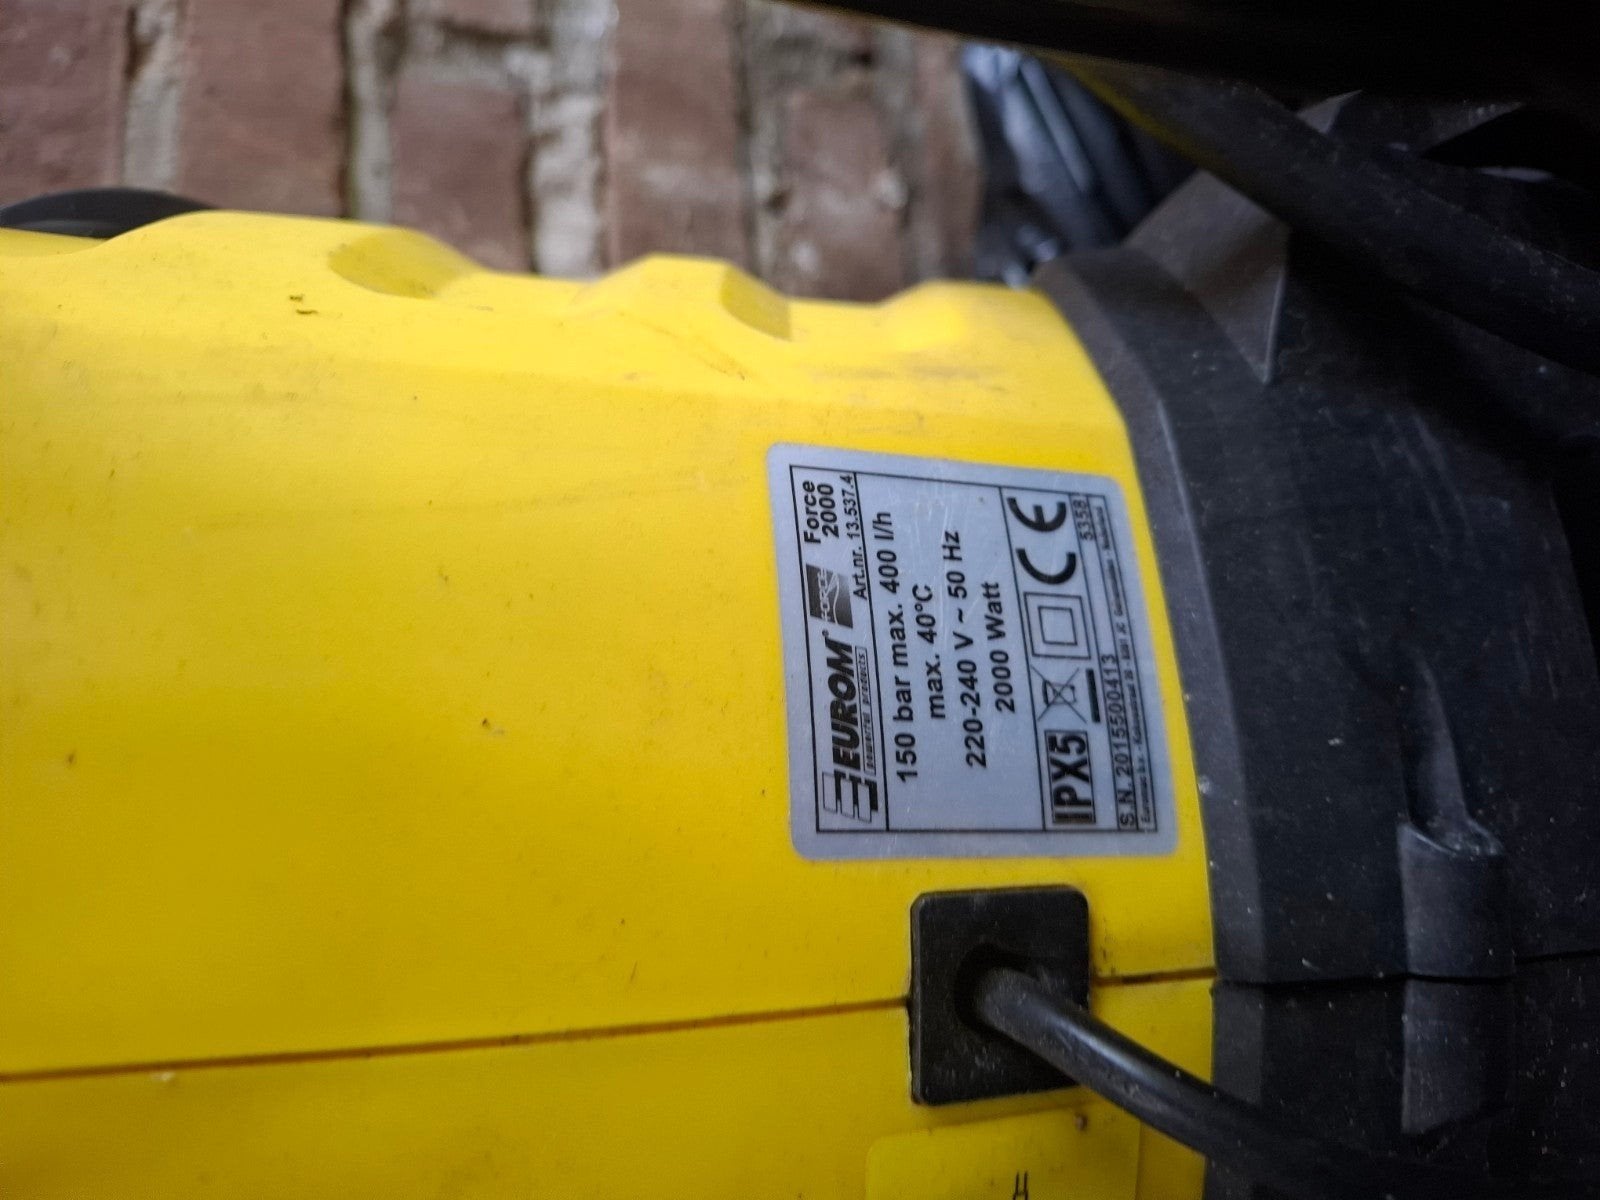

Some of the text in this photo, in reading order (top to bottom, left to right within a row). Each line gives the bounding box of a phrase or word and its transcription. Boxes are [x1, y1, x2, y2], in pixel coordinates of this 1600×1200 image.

[803, 480, 821, 544] Force
[817, 484, 839, 538] 2000
[840, 475, 868, 600] Art.nr. 13.537.4
[942, 531, 962, 562] Hz
[946, 571, 967, 599] 50
[856, 653, 871, 706] products
[873, 512, 918, 783] 150 bar max. 400 l/h
[912, 584, 945, 719] max. 40°C
[953, 631, 974, 650] V
[982, 582, 1015, 713] 2000 Watt
[825, 636, 861, 771] EUROM
[957, 659, 987, 768] 220-240
[1101, 653, 1132, 777] 2015500413
[1048, 734, 1092, 823] IPX5
